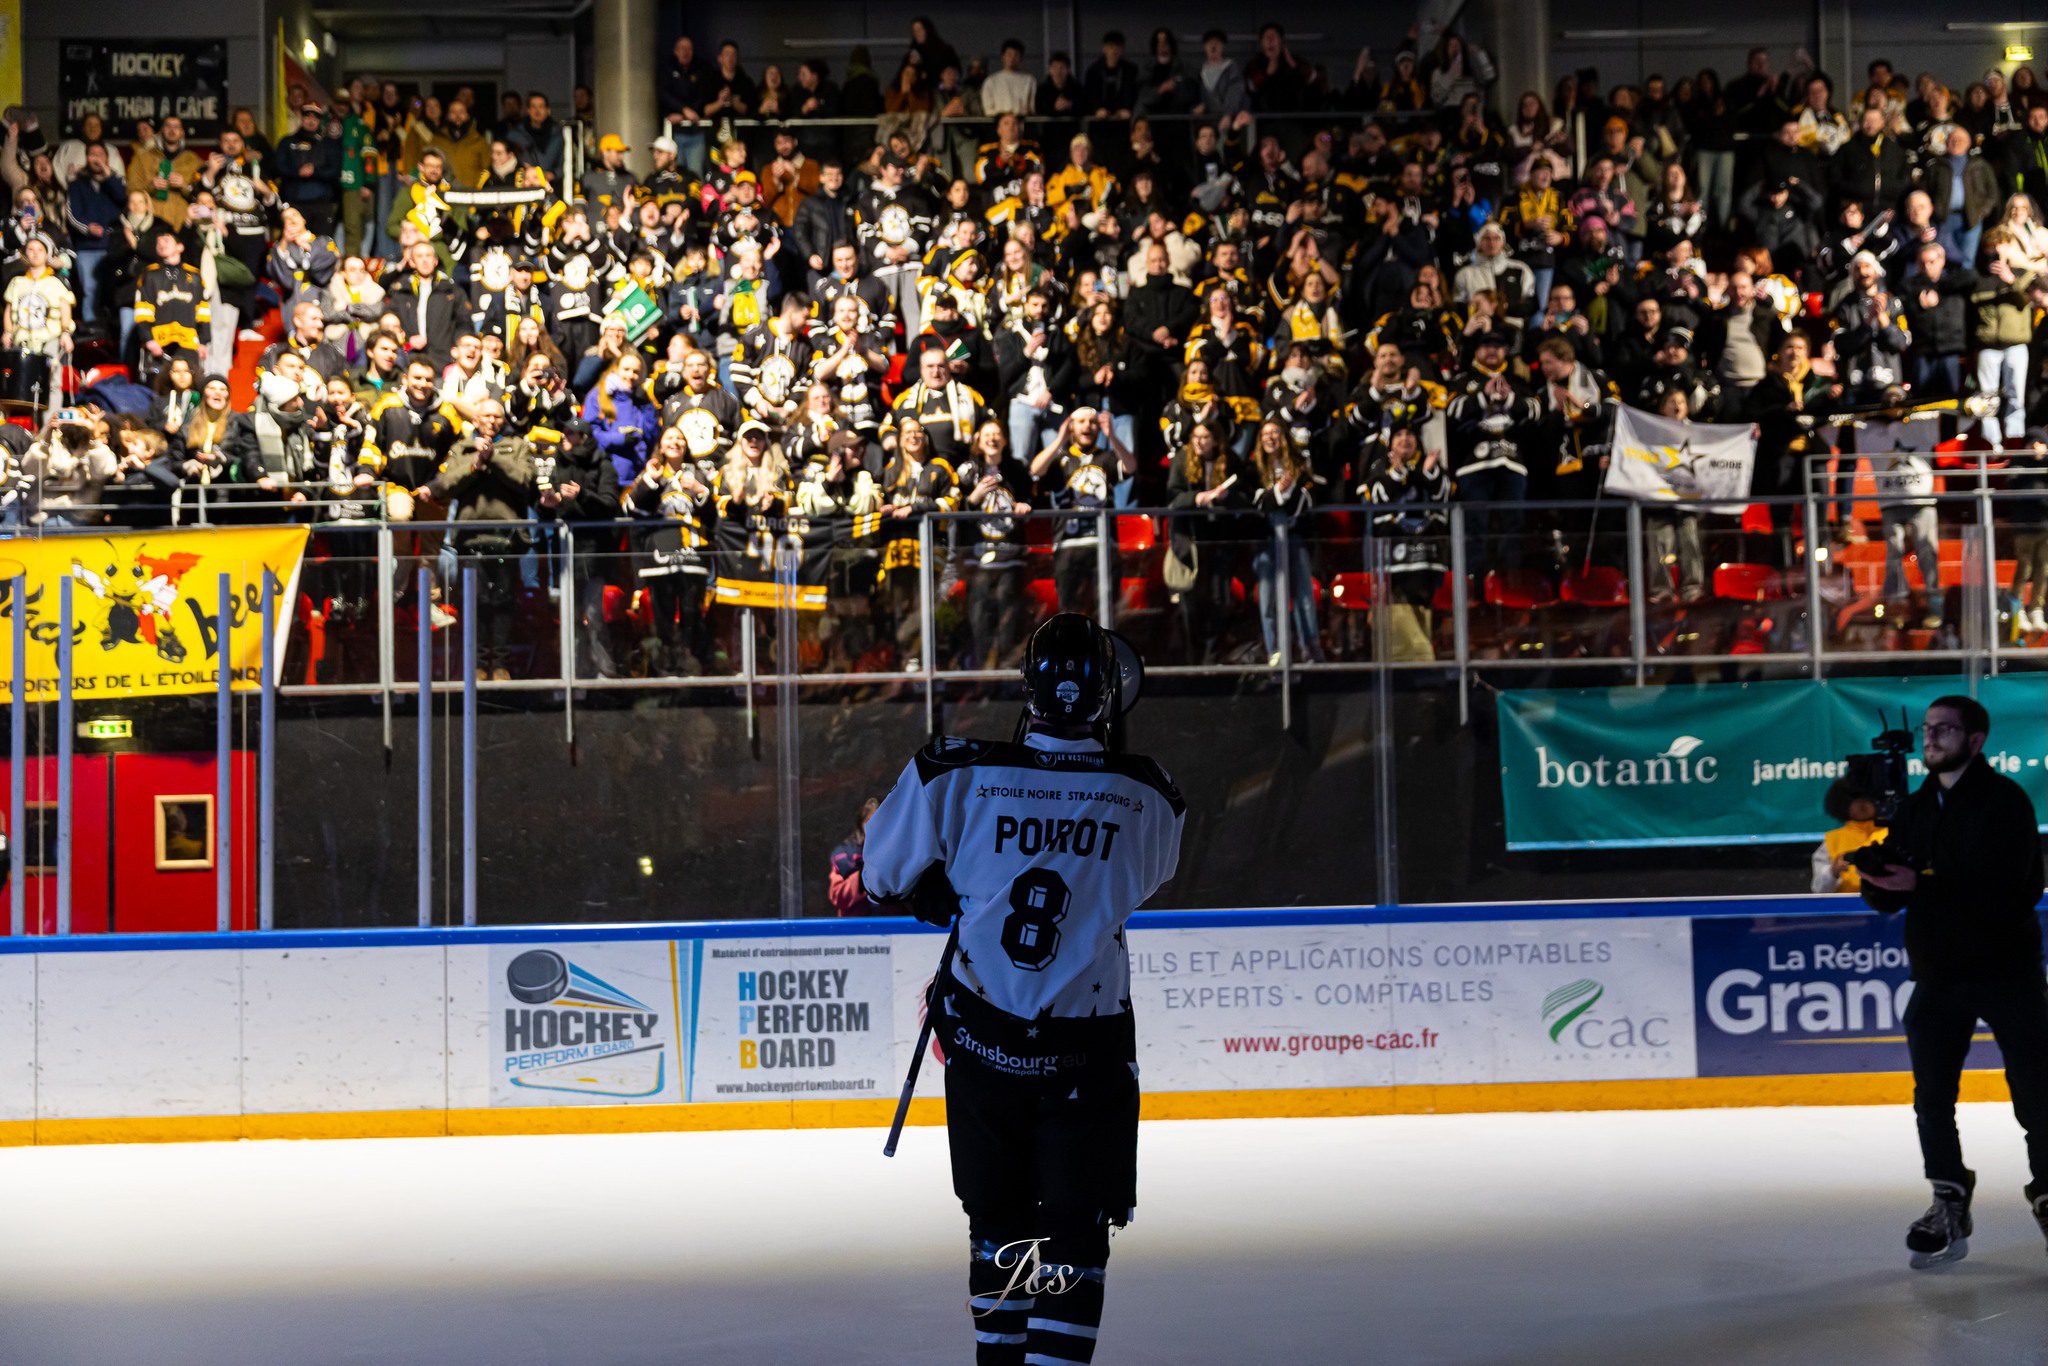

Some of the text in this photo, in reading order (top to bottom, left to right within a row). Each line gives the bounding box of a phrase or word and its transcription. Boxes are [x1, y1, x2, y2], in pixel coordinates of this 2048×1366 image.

[112, 52, 185, 77] HOCKEY
[69, 97, 218, 120] MORE THAN A GAME
[106, 674, 131, 689] DE
[1065, 704, 1073, 713] 8
[1536, 745, 1849, 788] botanic jardiner
[990, 786, 1131, 808] ETOILE NOIRE STRASBOURG
[994, 814, 1121, 862] POIROT
[1001, 867, 1072, 973] 8
[857, 944, 891, 955] hockey
[1190, 951, 1219, 972] ET
[1230, 946, 1423, 971] APPLICATIONS
[1433, 942, 1612, 968] COMPTABLES
[1768, 945, 1805, 972] La
[738, 969, 849, 1001] HOCKEY
[1165, 985, 1284, 1009] EXPERTS
[1315, 979, 1494, 1006] COMPTABLES
[505, 1008, 659, 1052] HOCKEY
[739, 1002, 870, 1035] PERFORM
[1576, 1015, 1670, 1049] cac
[505, 1039, 635, 1072] PERFORM BOARD
[739, 1038, 836, 1069] BOARD
[1223, 1027, 1439, 1057] www.groupe-cac.fr
